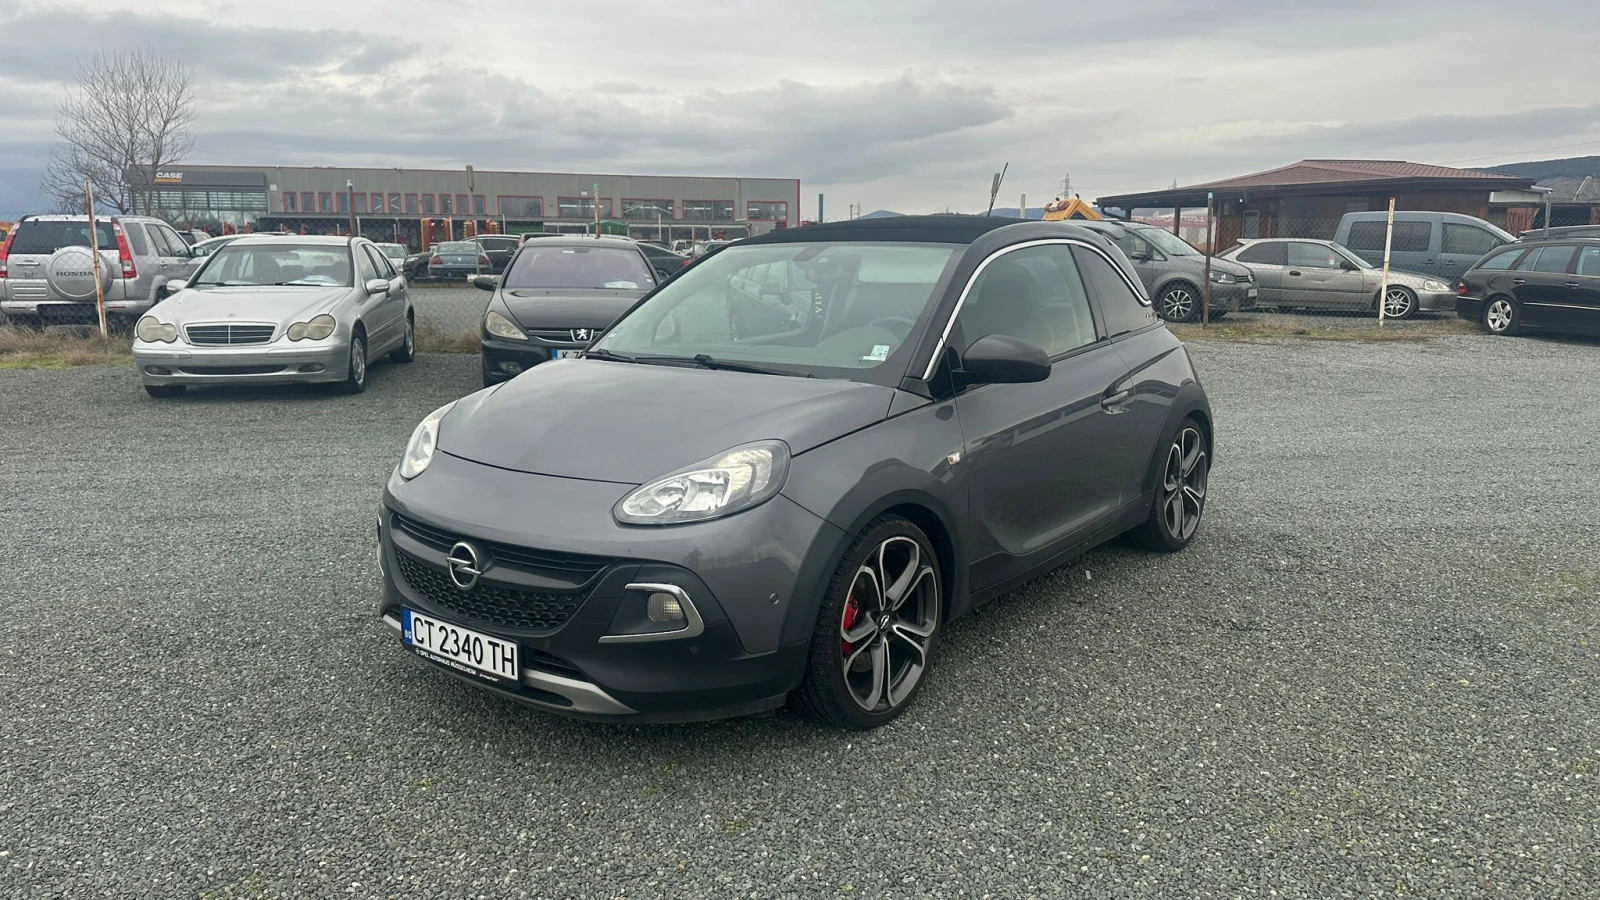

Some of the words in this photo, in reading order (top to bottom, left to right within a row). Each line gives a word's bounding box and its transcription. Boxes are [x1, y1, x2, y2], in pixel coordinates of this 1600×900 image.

[814, 292, 822, 314] VIP
[404, 630, 412, 640] BG
[413, 617, 435, 648] CT
[438, 625, 484, 665] 2340
[487, 639, 516, 676] TH
